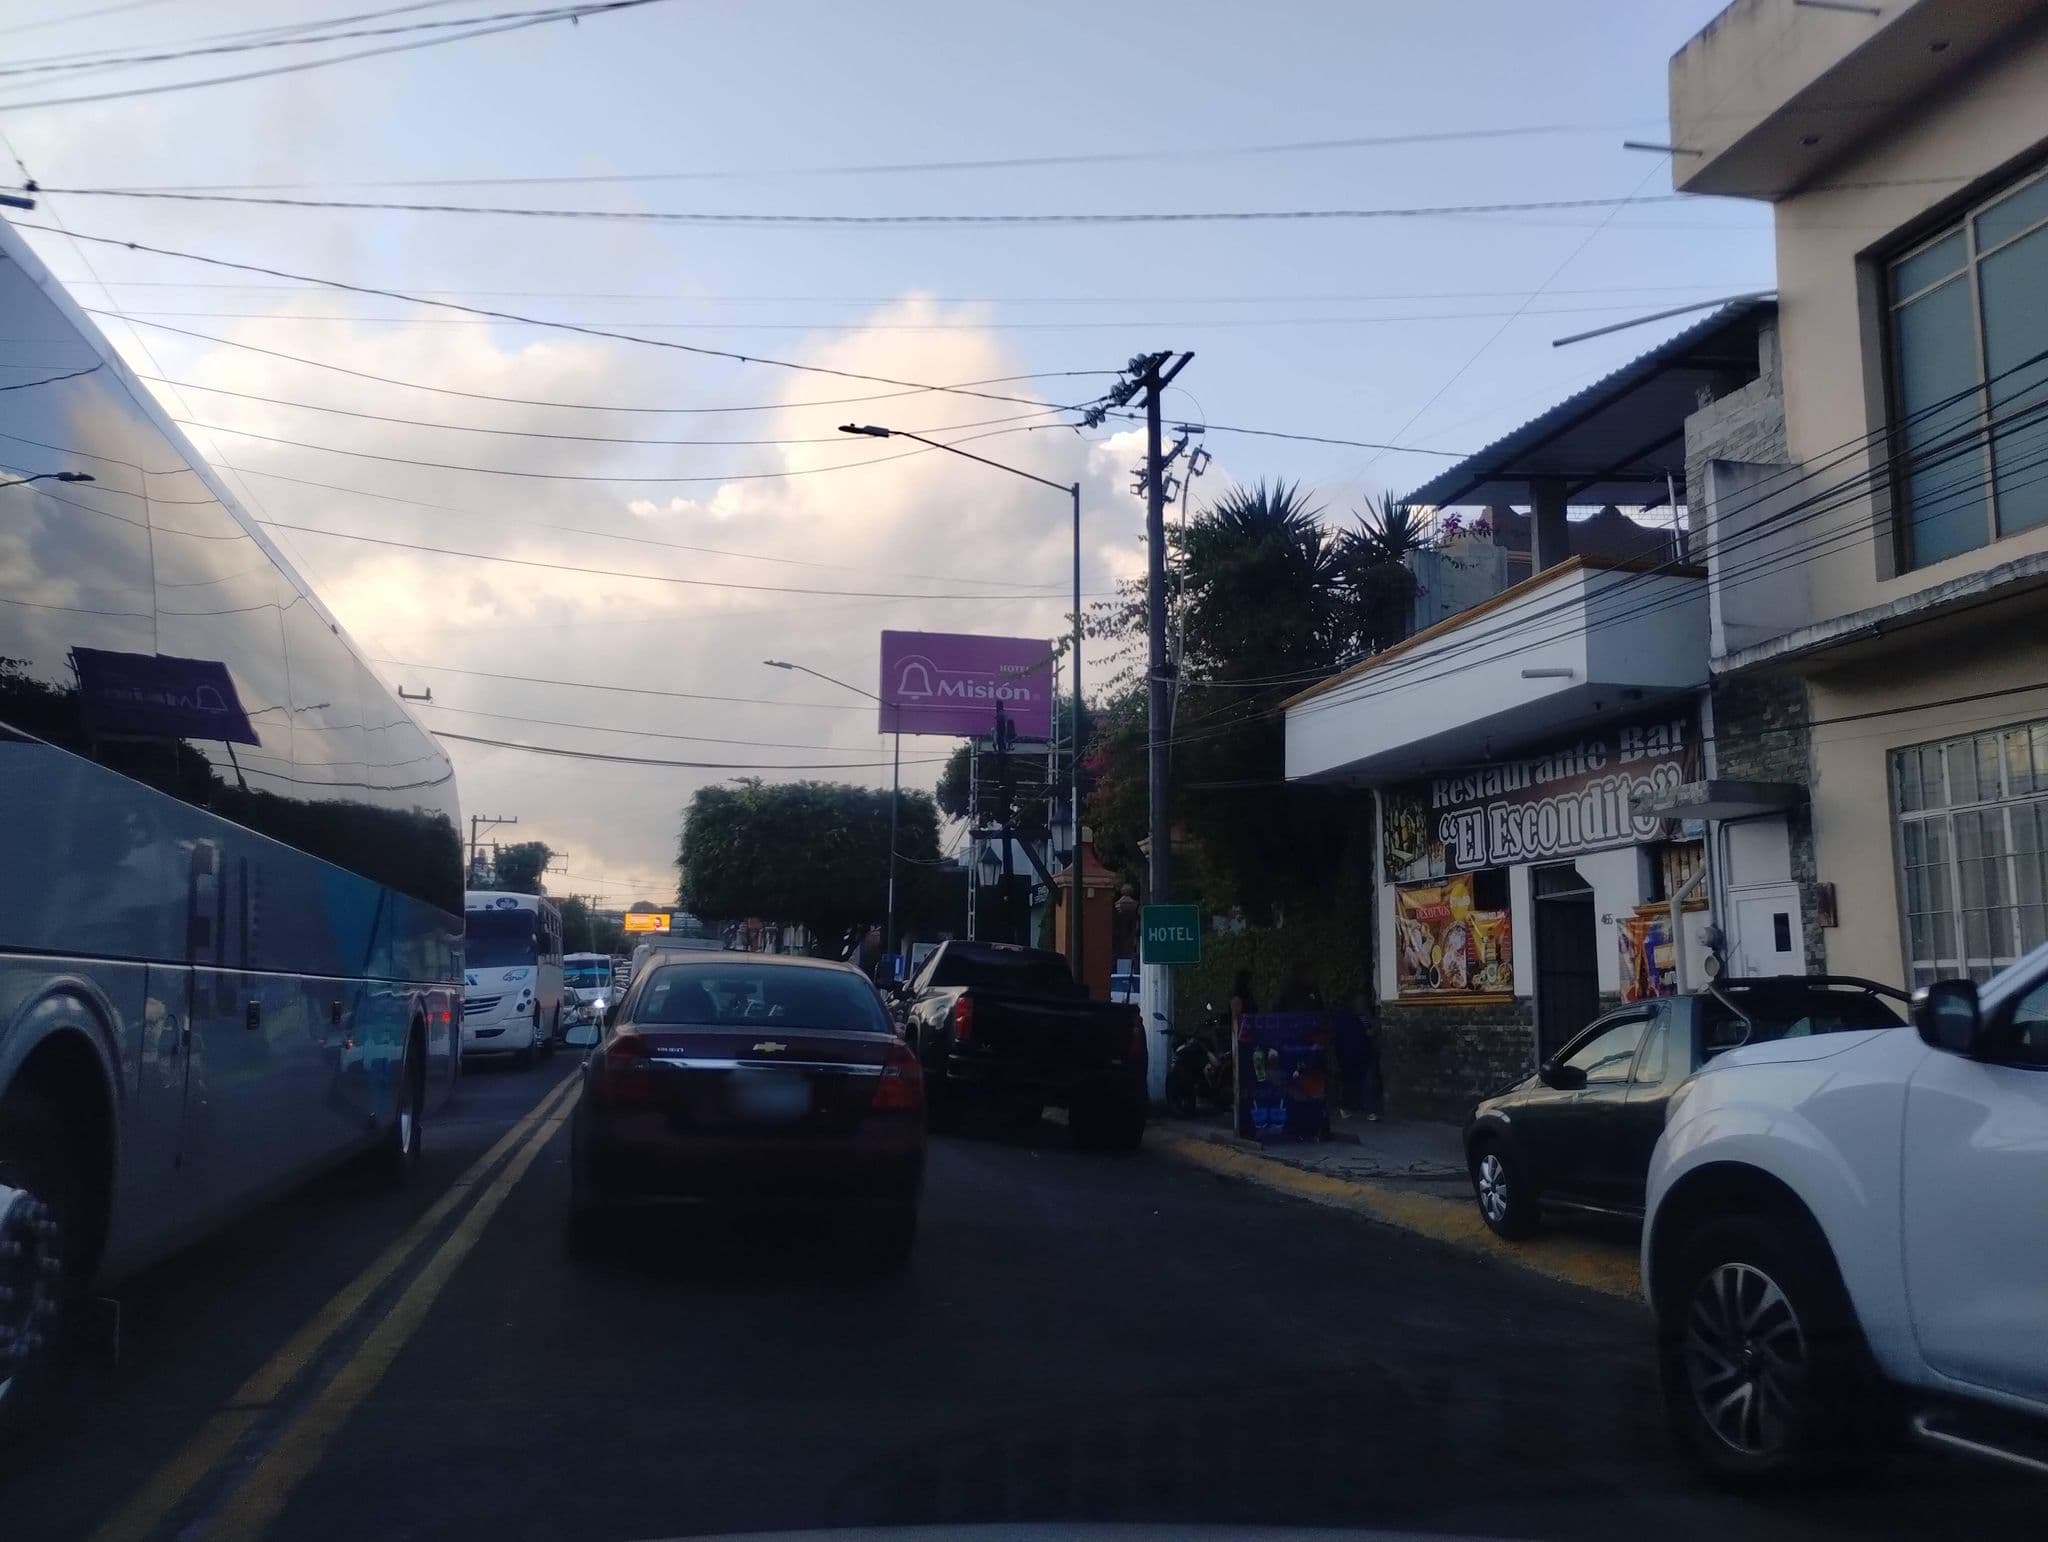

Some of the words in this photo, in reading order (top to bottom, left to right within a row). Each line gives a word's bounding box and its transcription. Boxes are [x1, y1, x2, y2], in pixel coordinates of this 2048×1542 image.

[937, 679, 1031, 701] Misión
[1431, 737, 1608, 808] Restaurante
[1617, 718, 1687, 764] Bar
[1148, 927, 1194, 942] HOTEL
